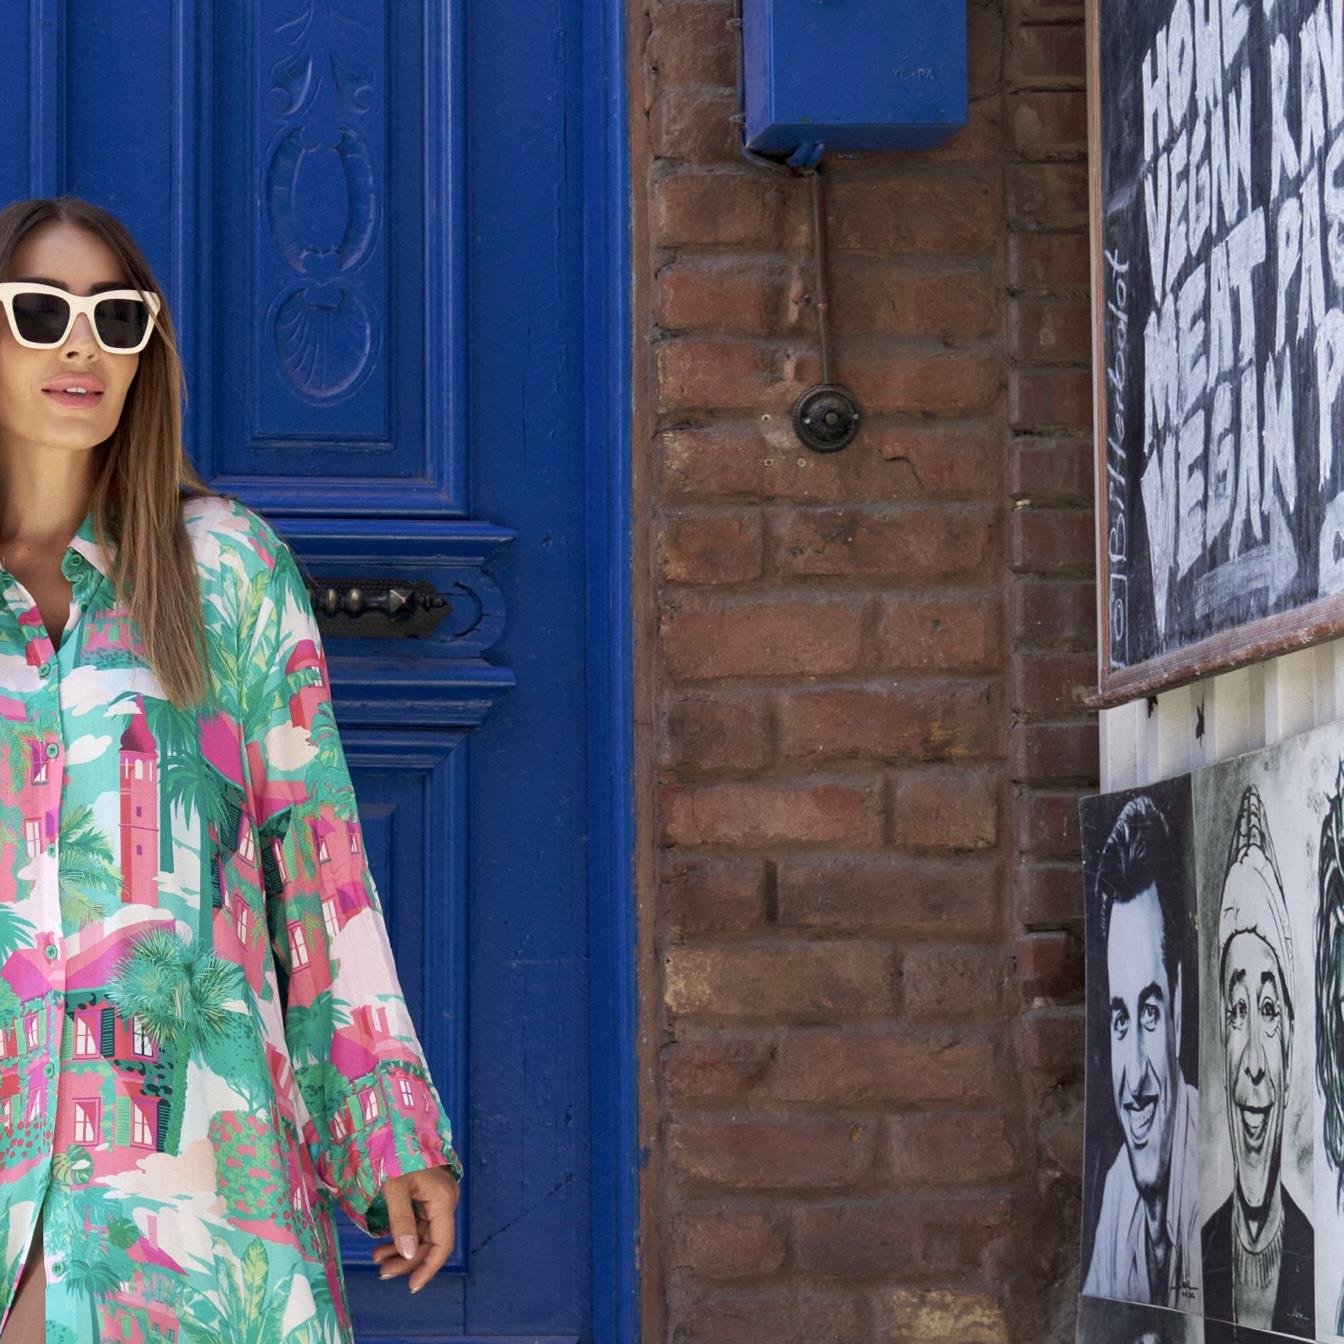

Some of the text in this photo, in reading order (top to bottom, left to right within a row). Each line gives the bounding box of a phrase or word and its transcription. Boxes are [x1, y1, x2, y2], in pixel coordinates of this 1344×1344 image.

[1144, 67, 1252, 306] VEGAN
[1144, 206, 1267, 455] MEAT
[1141, 344, 1298, 638] VEGAN
